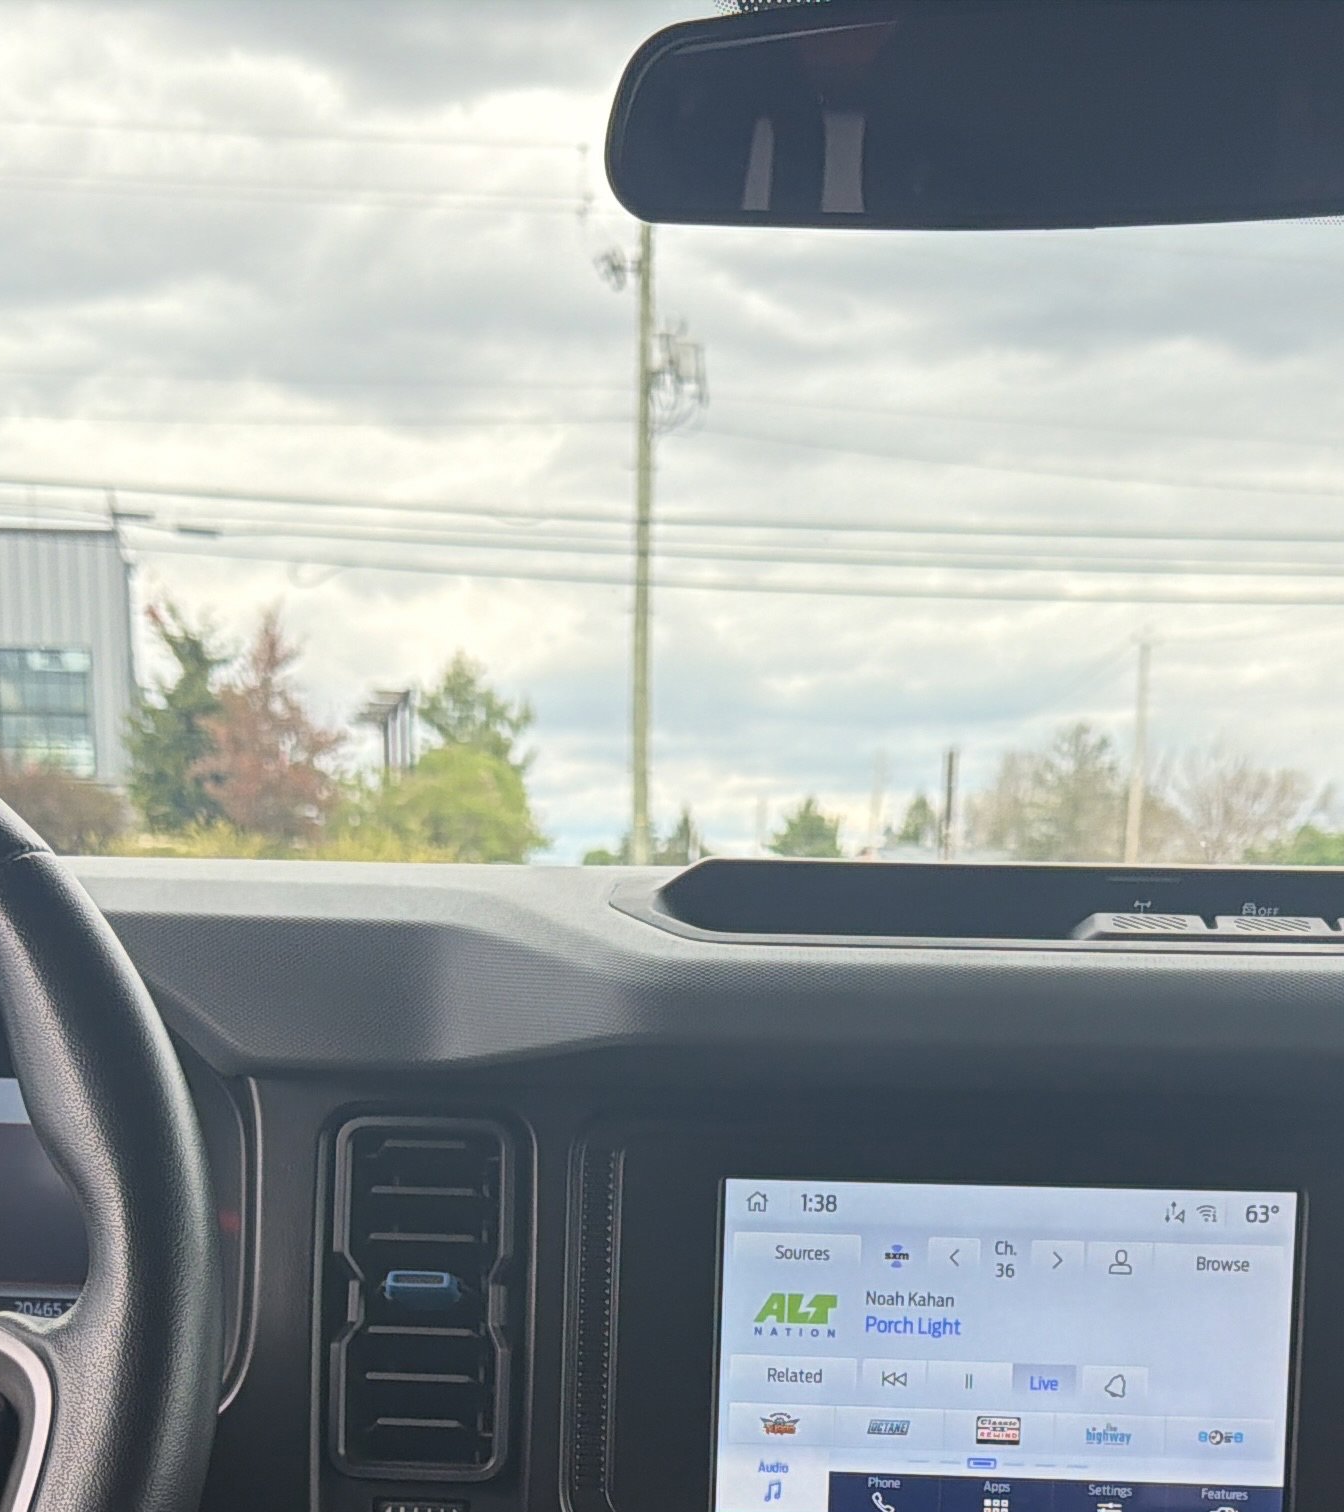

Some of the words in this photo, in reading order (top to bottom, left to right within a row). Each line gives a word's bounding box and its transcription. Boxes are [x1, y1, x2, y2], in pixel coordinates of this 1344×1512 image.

[1258, 907, 1280, 917] OFF
[801, 1194, 838, 1213] 1:38
[1245, 1204, 1280, 1224] 63°
[775, 1245, 831, 1263] Sources
[994, 1241, 1017, 1256] Ch.
[995, 1263, 1015, 1278] 36
[1196, 1256, 1251, 1273] Browse
[866, 1291, 905, 1308] Noah
[908, 1292, 955, 1309] Kahan
[754, 1293, 838, 1325] ALT
[754, 1326, 837, 1338] NATION
[865, 1316, 913, 1335] Porch
[917, 1317, 962, 1338] Light
[767, 1367, 823, 1385] Related
[1029, 1376, 1059, 1392] Live
[868, 1421, 908, 1434] OCTANE
[979, 1431, 1018, 1440] REWIND
[1086, 1427, 1132, 1445] highway
[758, 1461, 789, 1473] Audio
[868, 1477, 901, 1490] Phone
[984, 1481, 1010, 1493] Apps
[1088, 1484, 1133, 1498] Settings
[1201, 1488, 1249, 1501] Features
